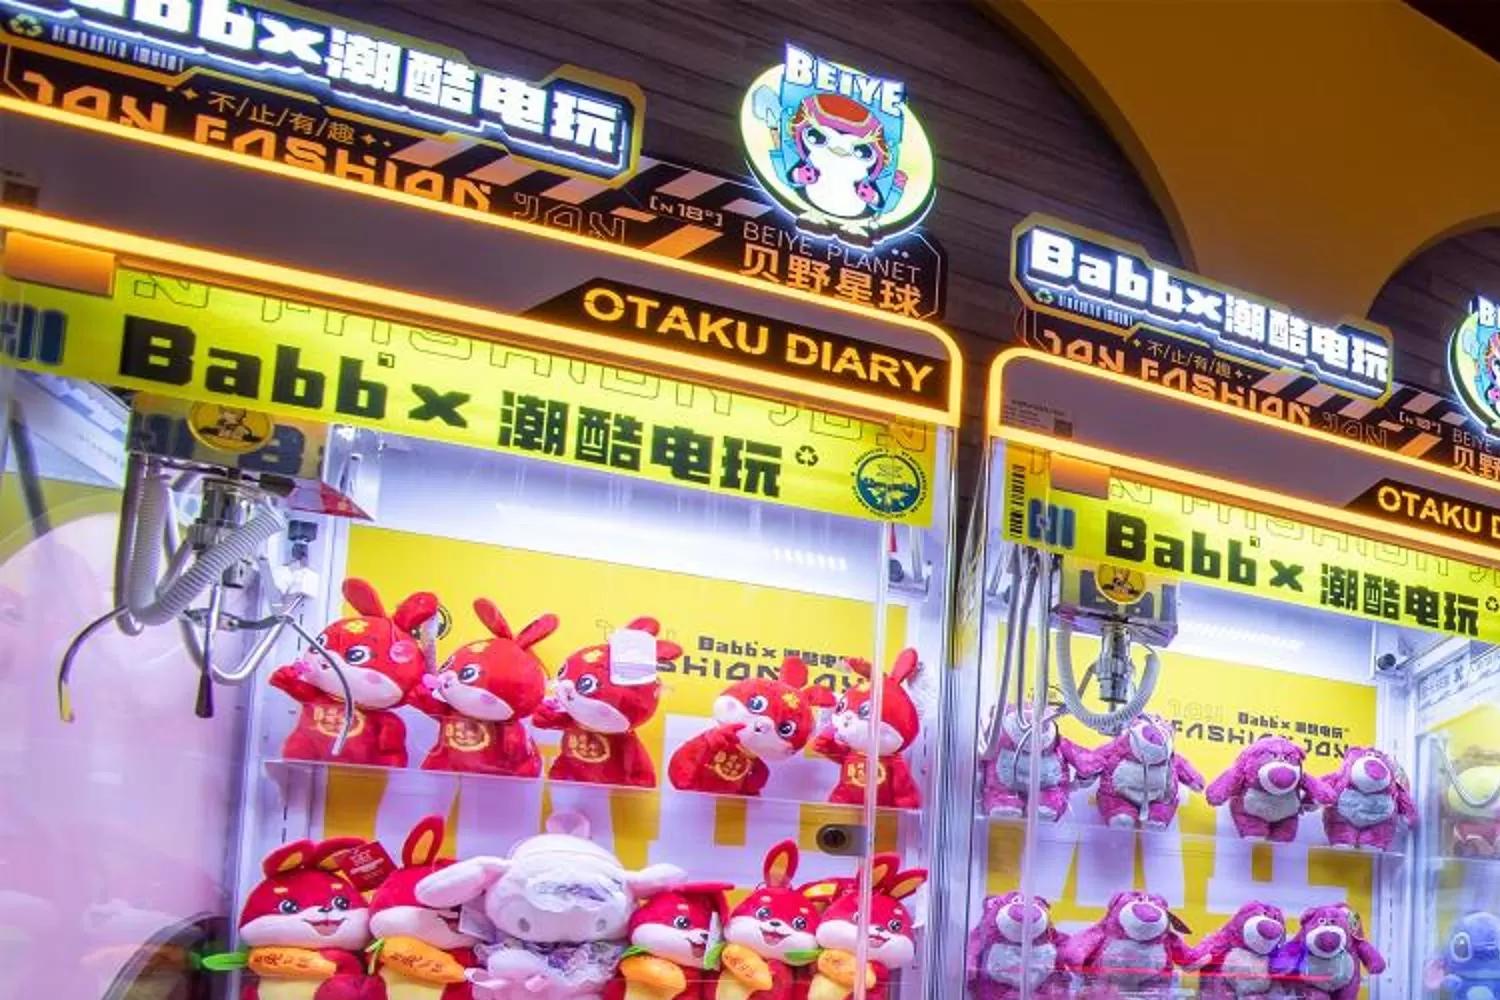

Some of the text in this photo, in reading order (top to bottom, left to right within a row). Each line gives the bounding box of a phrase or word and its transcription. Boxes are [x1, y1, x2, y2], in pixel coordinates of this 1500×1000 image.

[784, 41, 905, 109] BEIYE
[740, 243, 922, 319] 贝野星球
[743, 220, 922, 284] BEIYE PLANET
[583, 287, 936, 394] OTAKU DIARY
[500, 390, 783, 499] 潮酷电玩
[1377, 485, 1482, 534] OTAKU
[1320, 563, 1479, 637] 潮酷电玩
